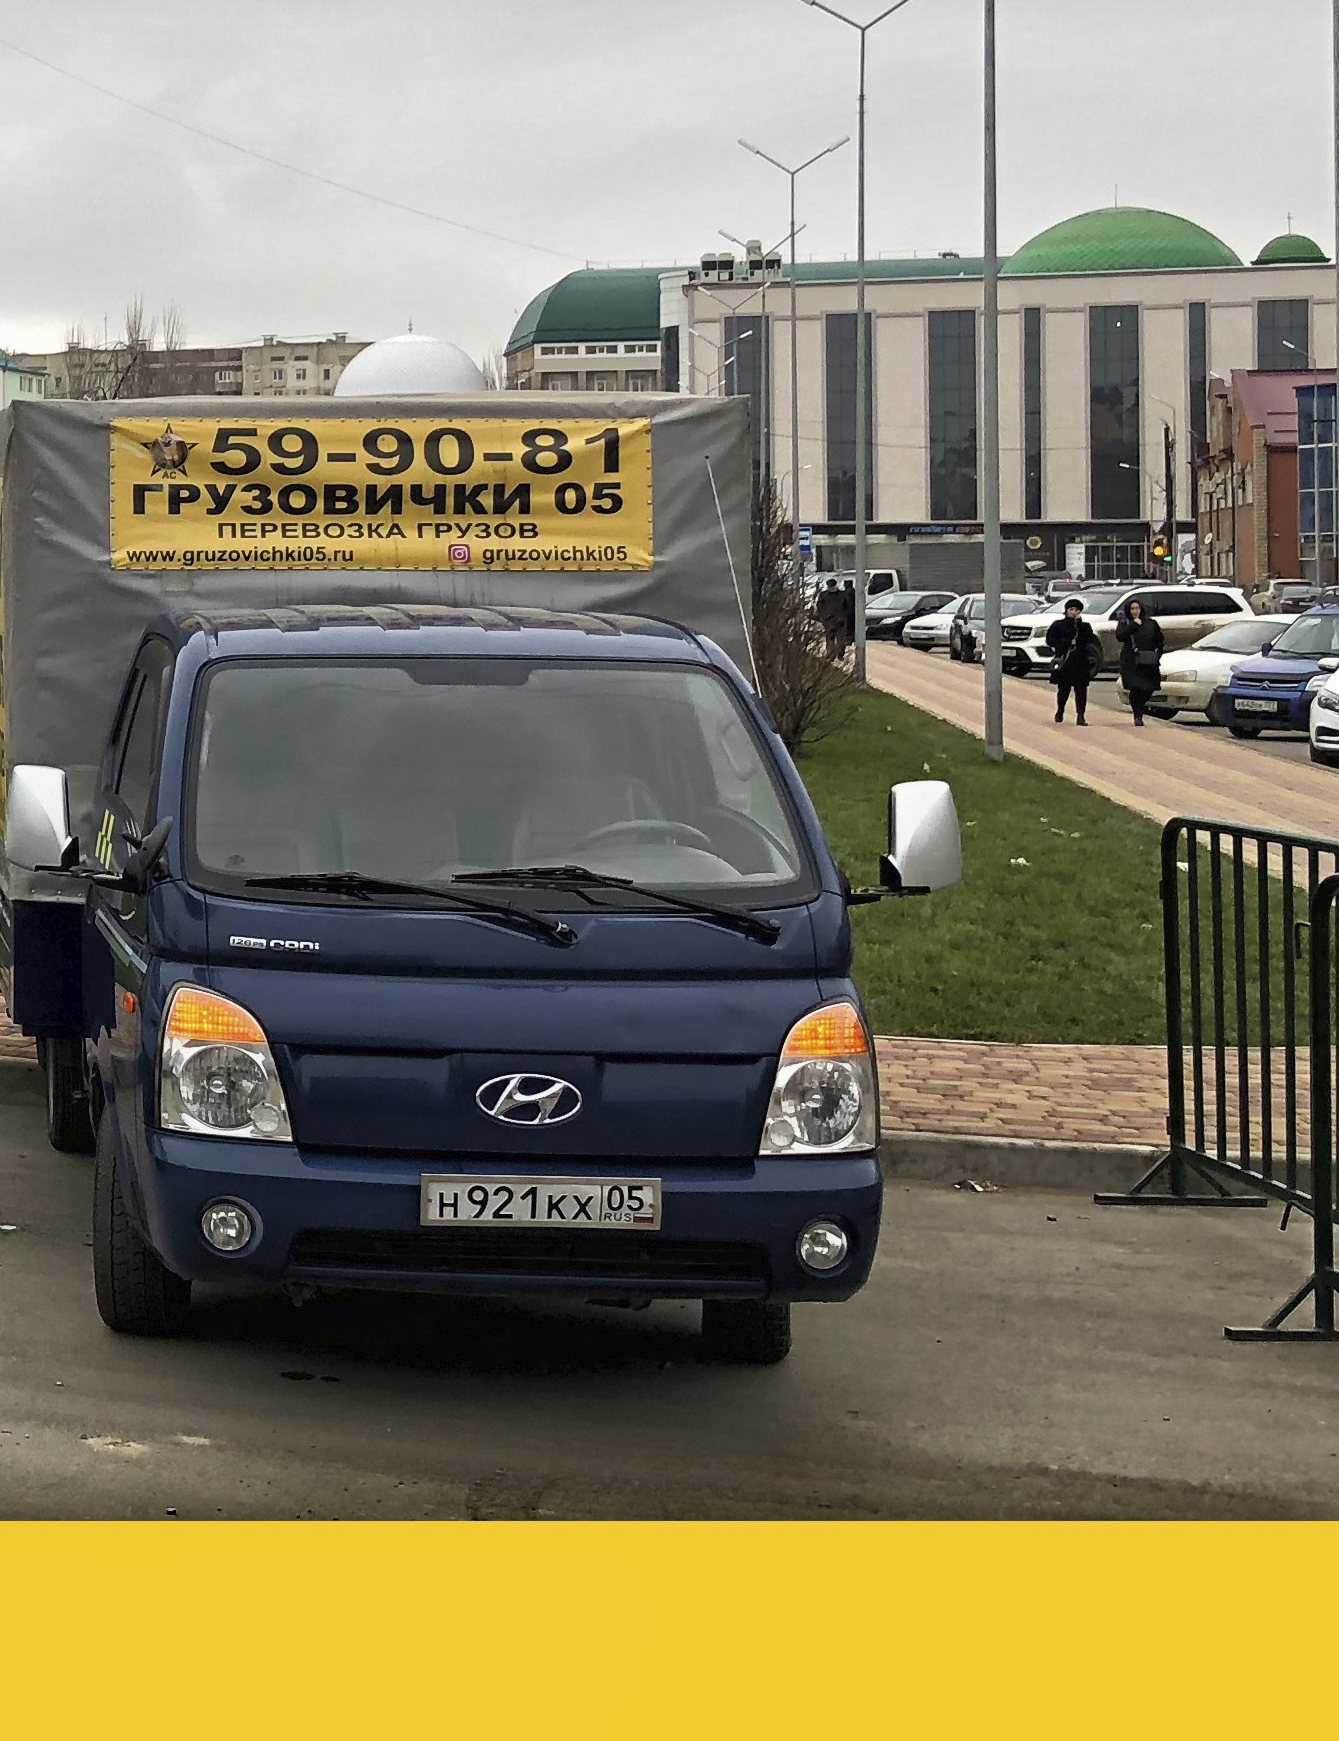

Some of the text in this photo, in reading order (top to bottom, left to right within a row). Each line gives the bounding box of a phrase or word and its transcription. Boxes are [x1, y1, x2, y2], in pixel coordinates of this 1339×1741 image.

[210, 427, 619, 475] 59-90-81
[133, 482, 623, 515] ГРУЗОВИЧКИ 05
[218, 523, 538, 538] ПЕРЕВОЗКА ГРУЗОВ
[127, 546, 627, 566] www.gruzovichki05.ru gruzovichki05
[438, 1185, 644, 1220] Н921КХ 05
[604, 1212, 632, 1222] RUS
